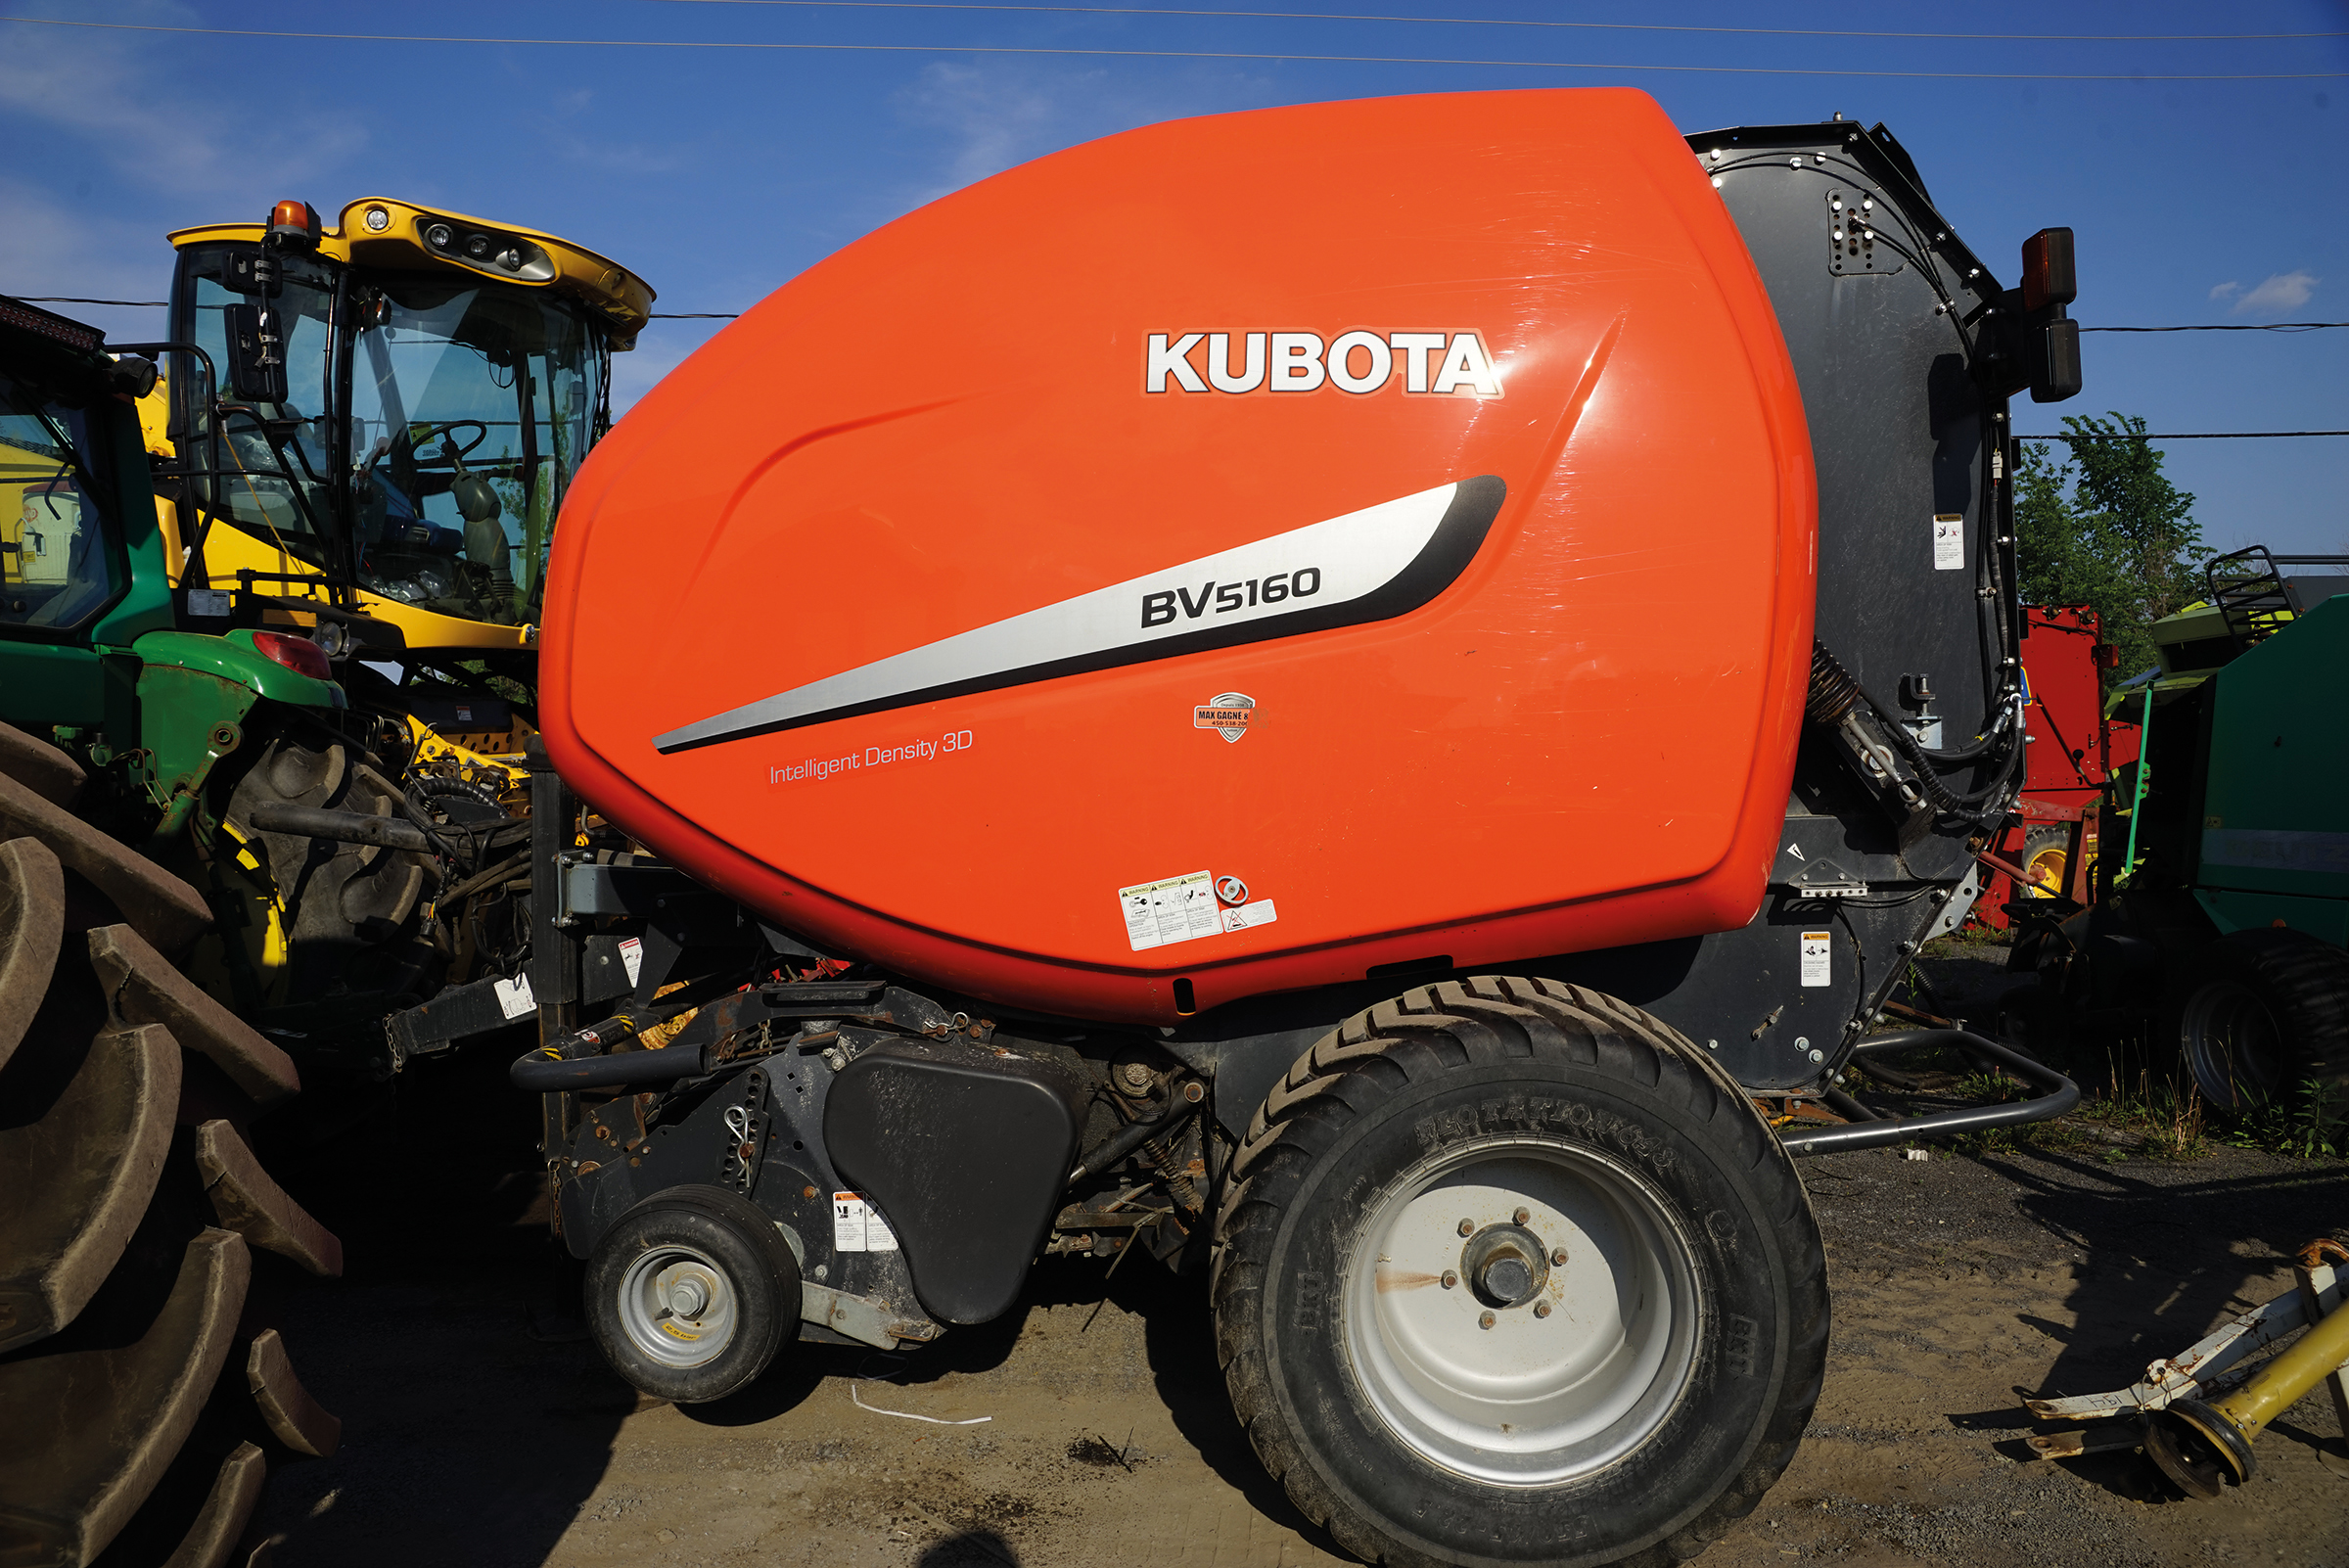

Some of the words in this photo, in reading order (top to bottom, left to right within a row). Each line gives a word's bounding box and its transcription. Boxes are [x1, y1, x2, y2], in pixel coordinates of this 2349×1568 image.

[1145, 329, 1500, 395] KUBOTA
[1140, 567, 1321, 629] BV5160
[1198, 711, 1215, 719] MAX
[1217, 710, 1242, 720] GAGNÉ
[769, 752, 860, 785] Intelligent
[865, 739, 938, 767] Density
[943, 729, 973, 753] 3D
[1187, 873, 1209, 883] WARNING
[1158, 880, 1178, 889] WARNING
[1128, 886, 1149, 896] WARNING
